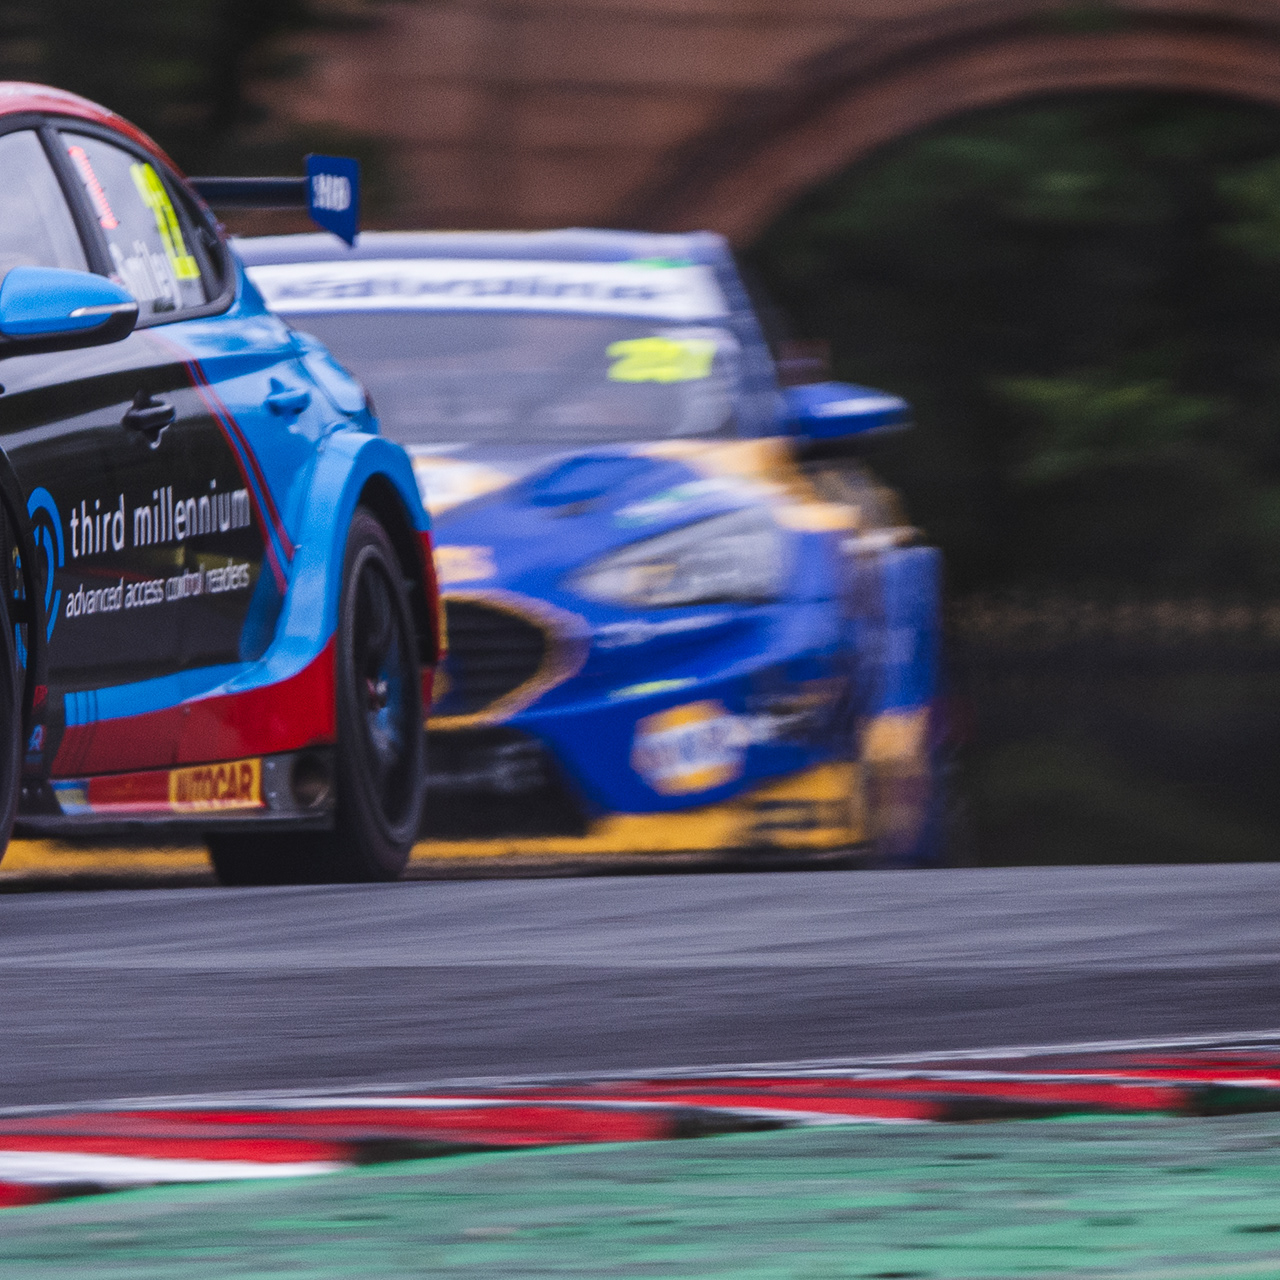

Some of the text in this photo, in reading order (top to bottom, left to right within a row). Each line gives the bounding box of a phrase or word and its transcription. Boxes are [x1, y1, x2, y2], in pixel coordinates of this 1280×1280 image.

[70, 478, 251, 558] third millennium
[66, 558, 251, 618] advanced access control readers
